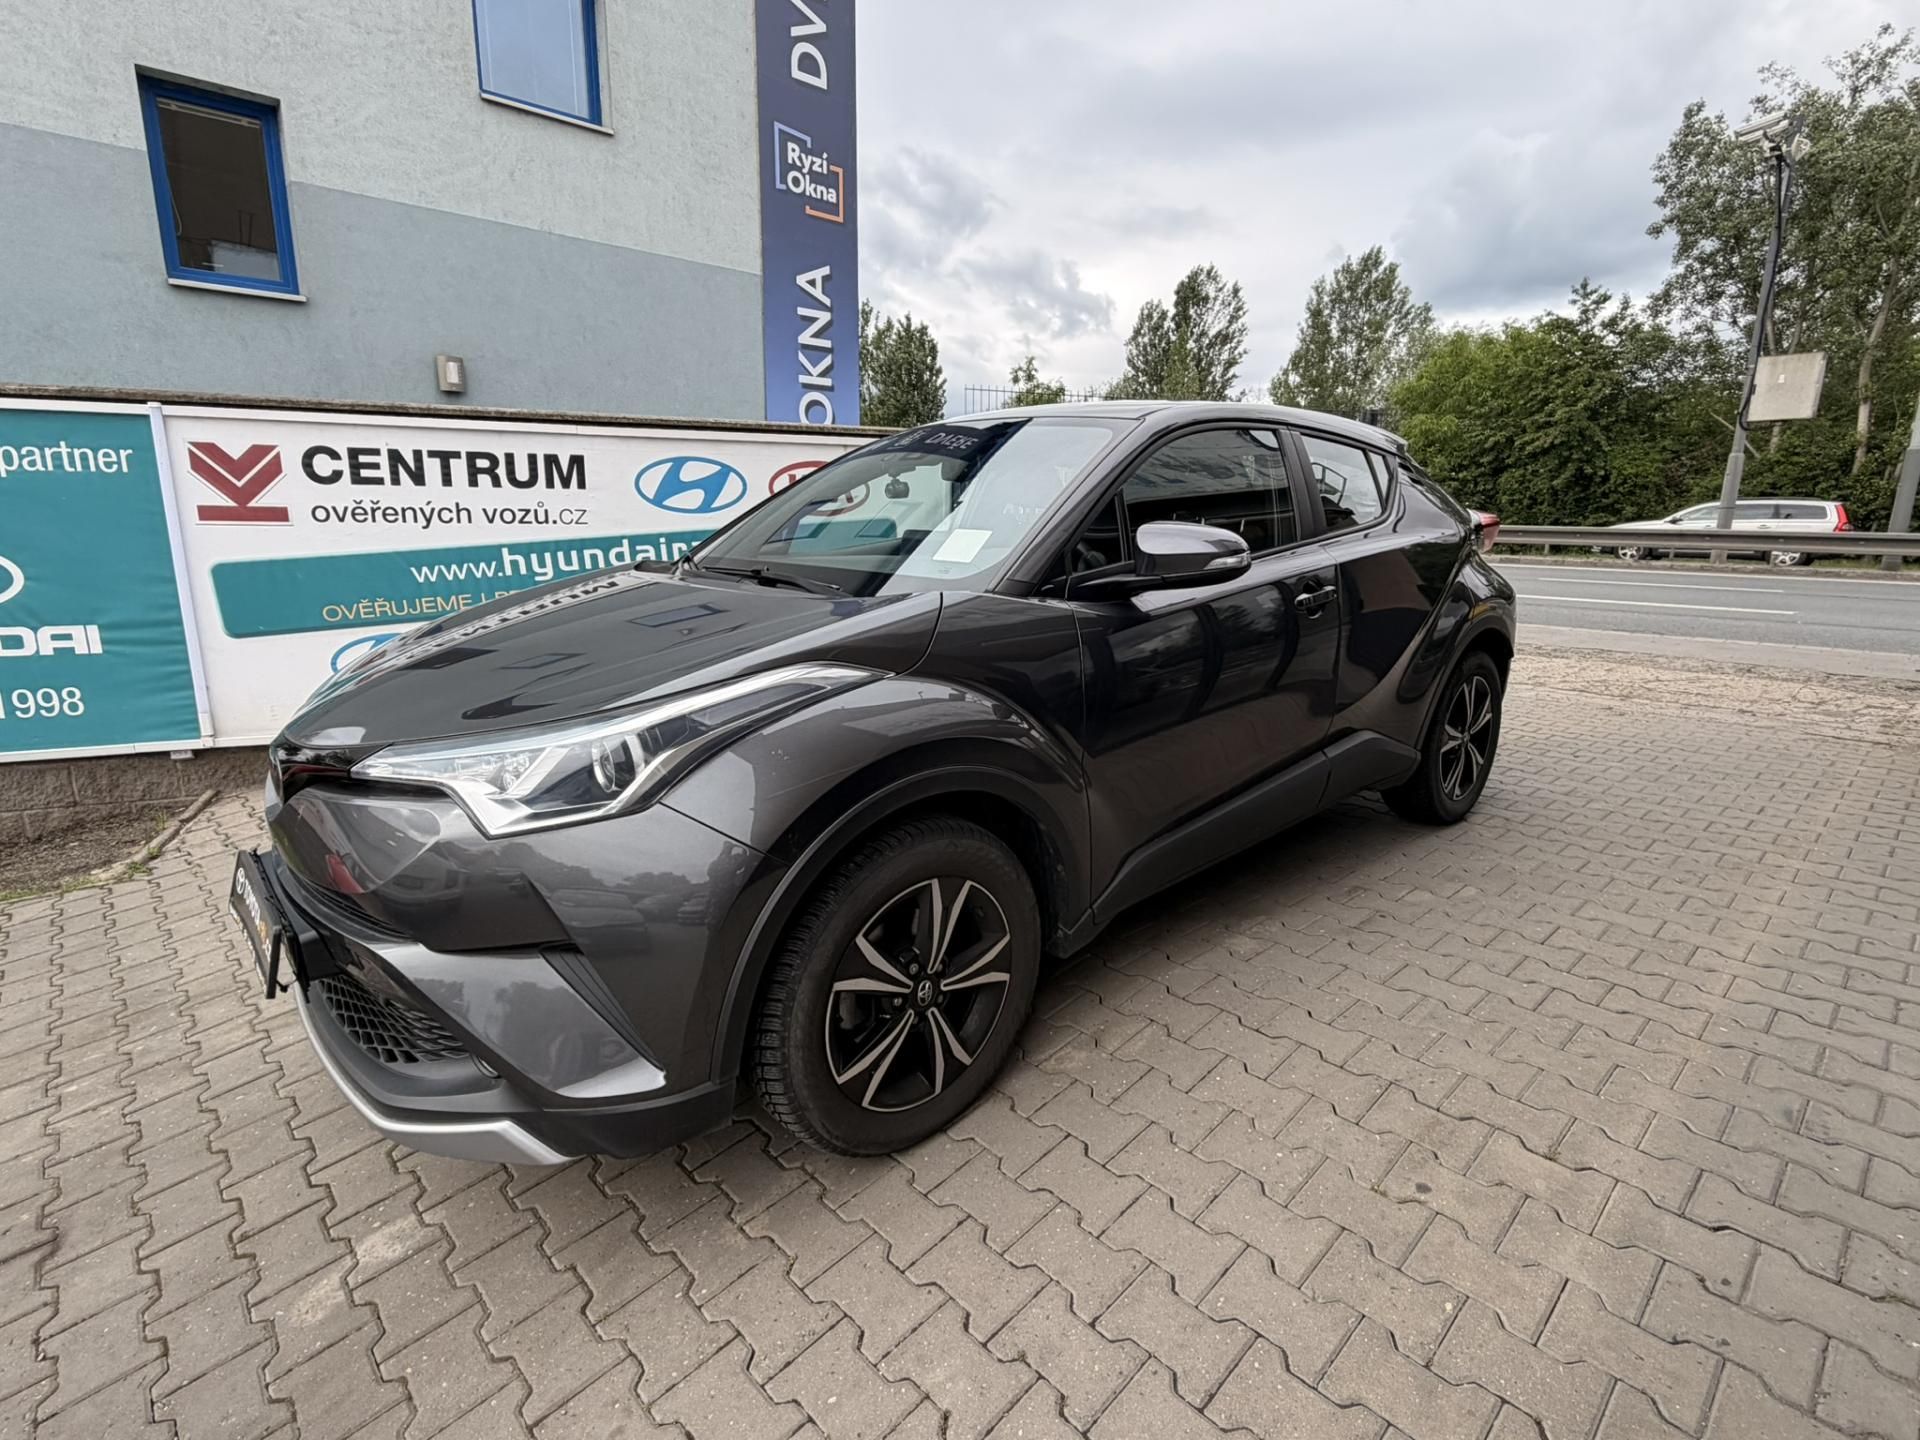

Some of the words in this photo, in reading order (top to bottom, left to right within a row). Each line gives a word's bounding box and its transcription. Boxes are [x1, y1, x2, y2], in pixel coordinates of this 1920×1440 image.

[786, 141, 828, 174] Ryzí
[786, 170, 837, 203] Okna
[796, 265, 833, 426] OKNA
[0, 440, 133, 478] partner
[301, 445, 587, 489] CENTRUM
[311, 500, 473, 530] ověřených
[482, 502, 589, 525] vozů.cz
[322, 594, 473, 622] OVĚŘUJEME
